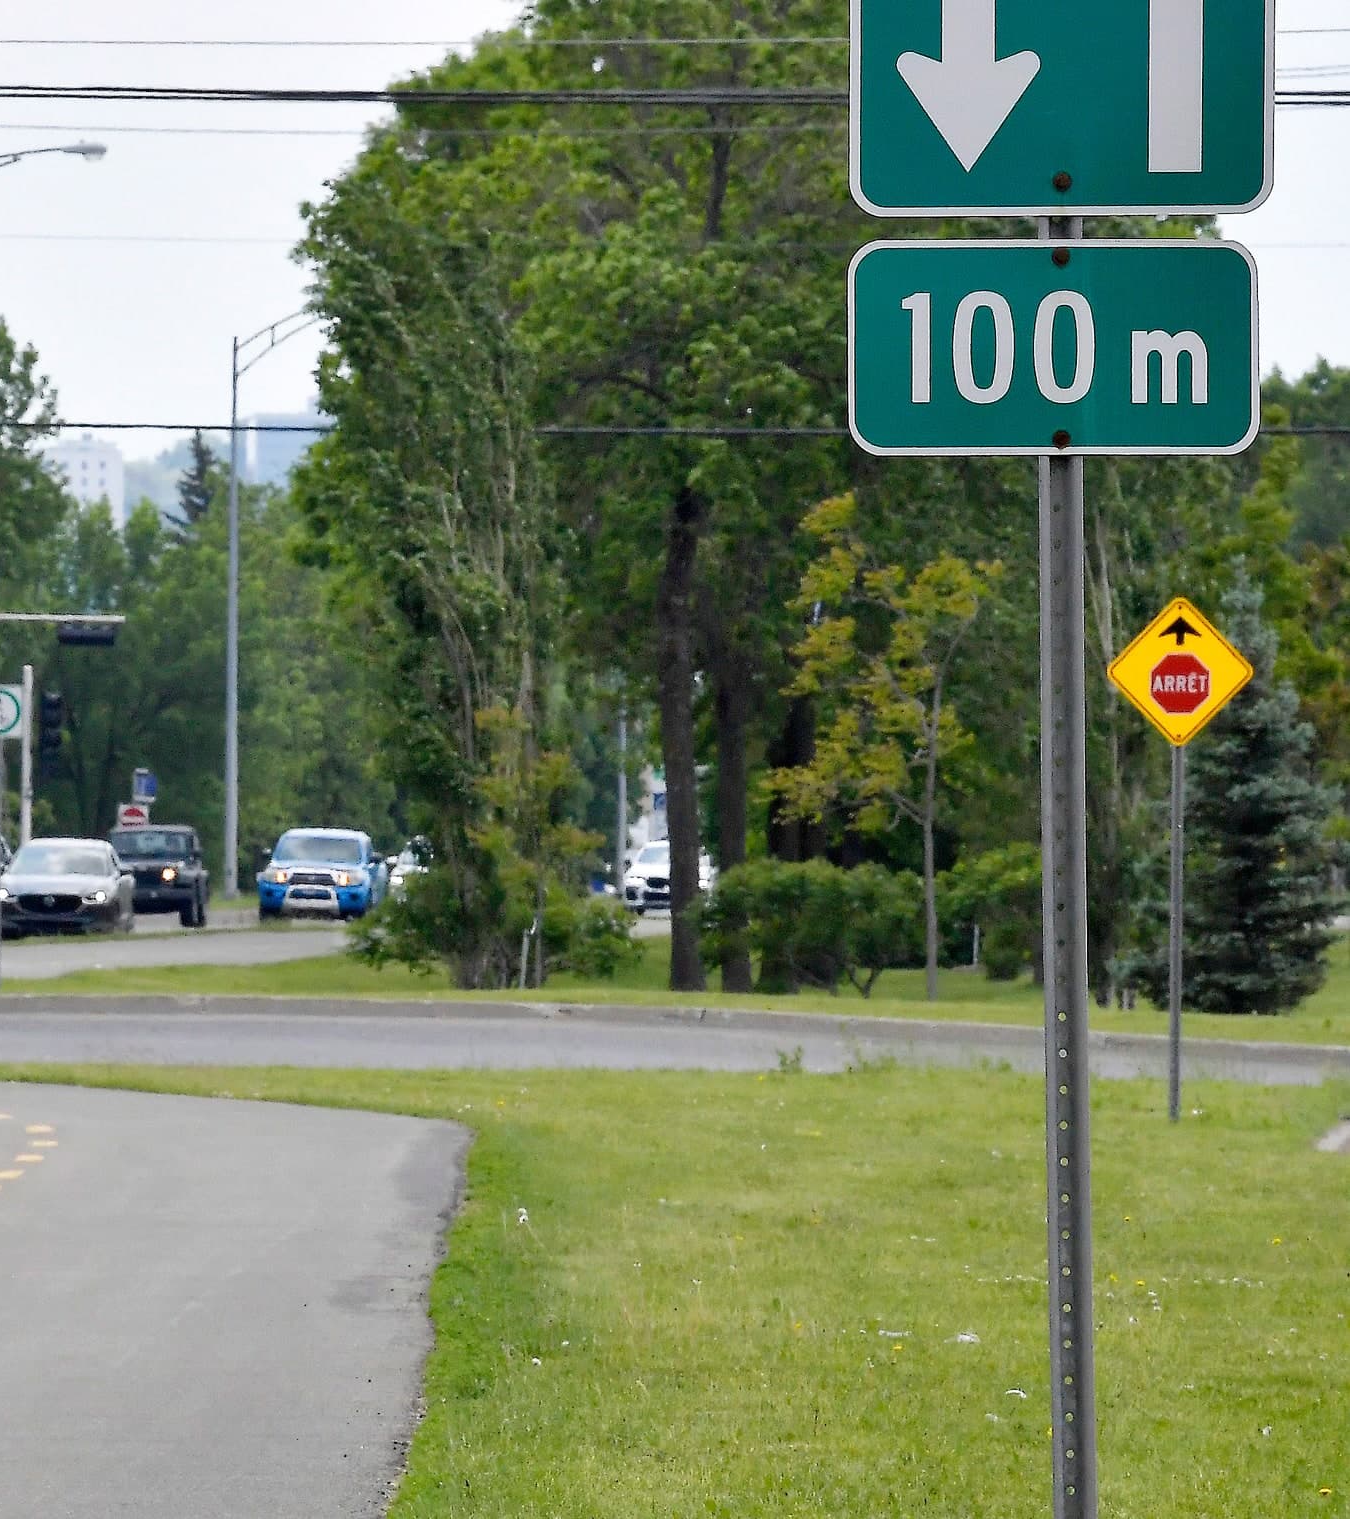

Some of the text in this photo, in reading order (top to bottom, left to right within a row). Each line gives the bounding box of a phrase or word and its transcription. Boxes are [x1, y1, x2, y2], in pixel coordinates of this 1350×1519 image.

[901, 289, 1209, 405] 100 m
[1152, 672, 1208, 694] ARRÊT
